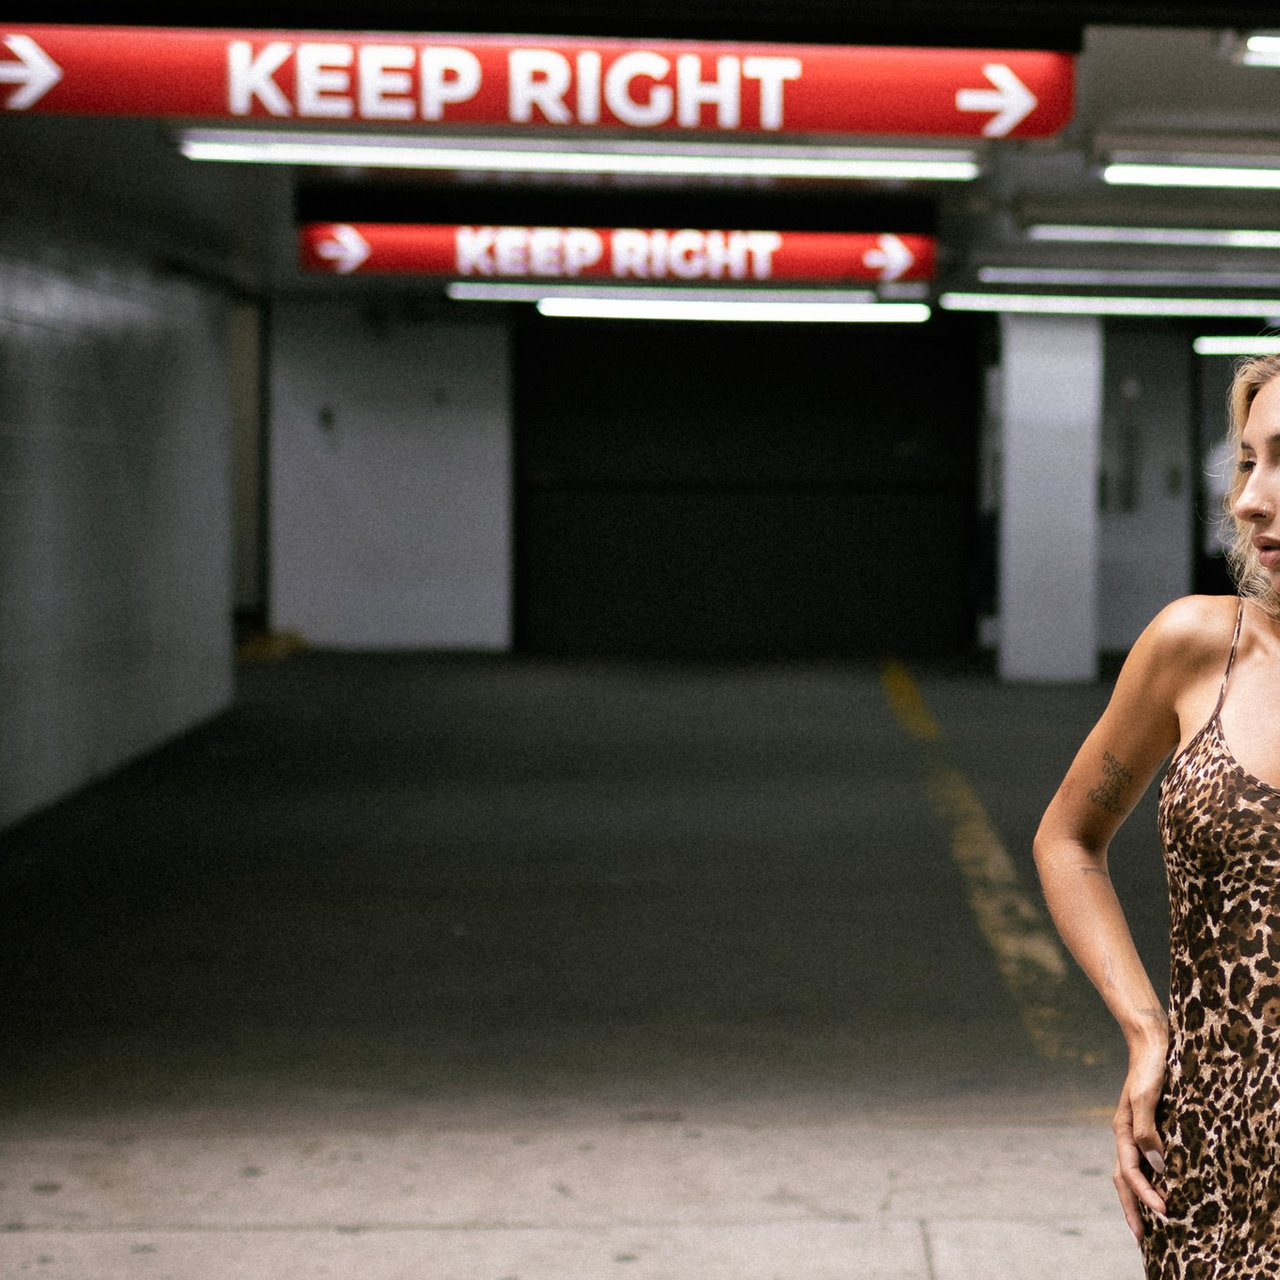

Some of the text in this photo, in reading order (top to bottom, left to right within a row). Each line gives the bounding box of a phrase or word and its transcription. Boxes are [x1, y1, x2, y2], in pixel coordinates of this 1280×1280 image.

[225, 39, 803, 131] KEEP RIGHT
[453, 226, 783, 280] KEEP RIGHT
